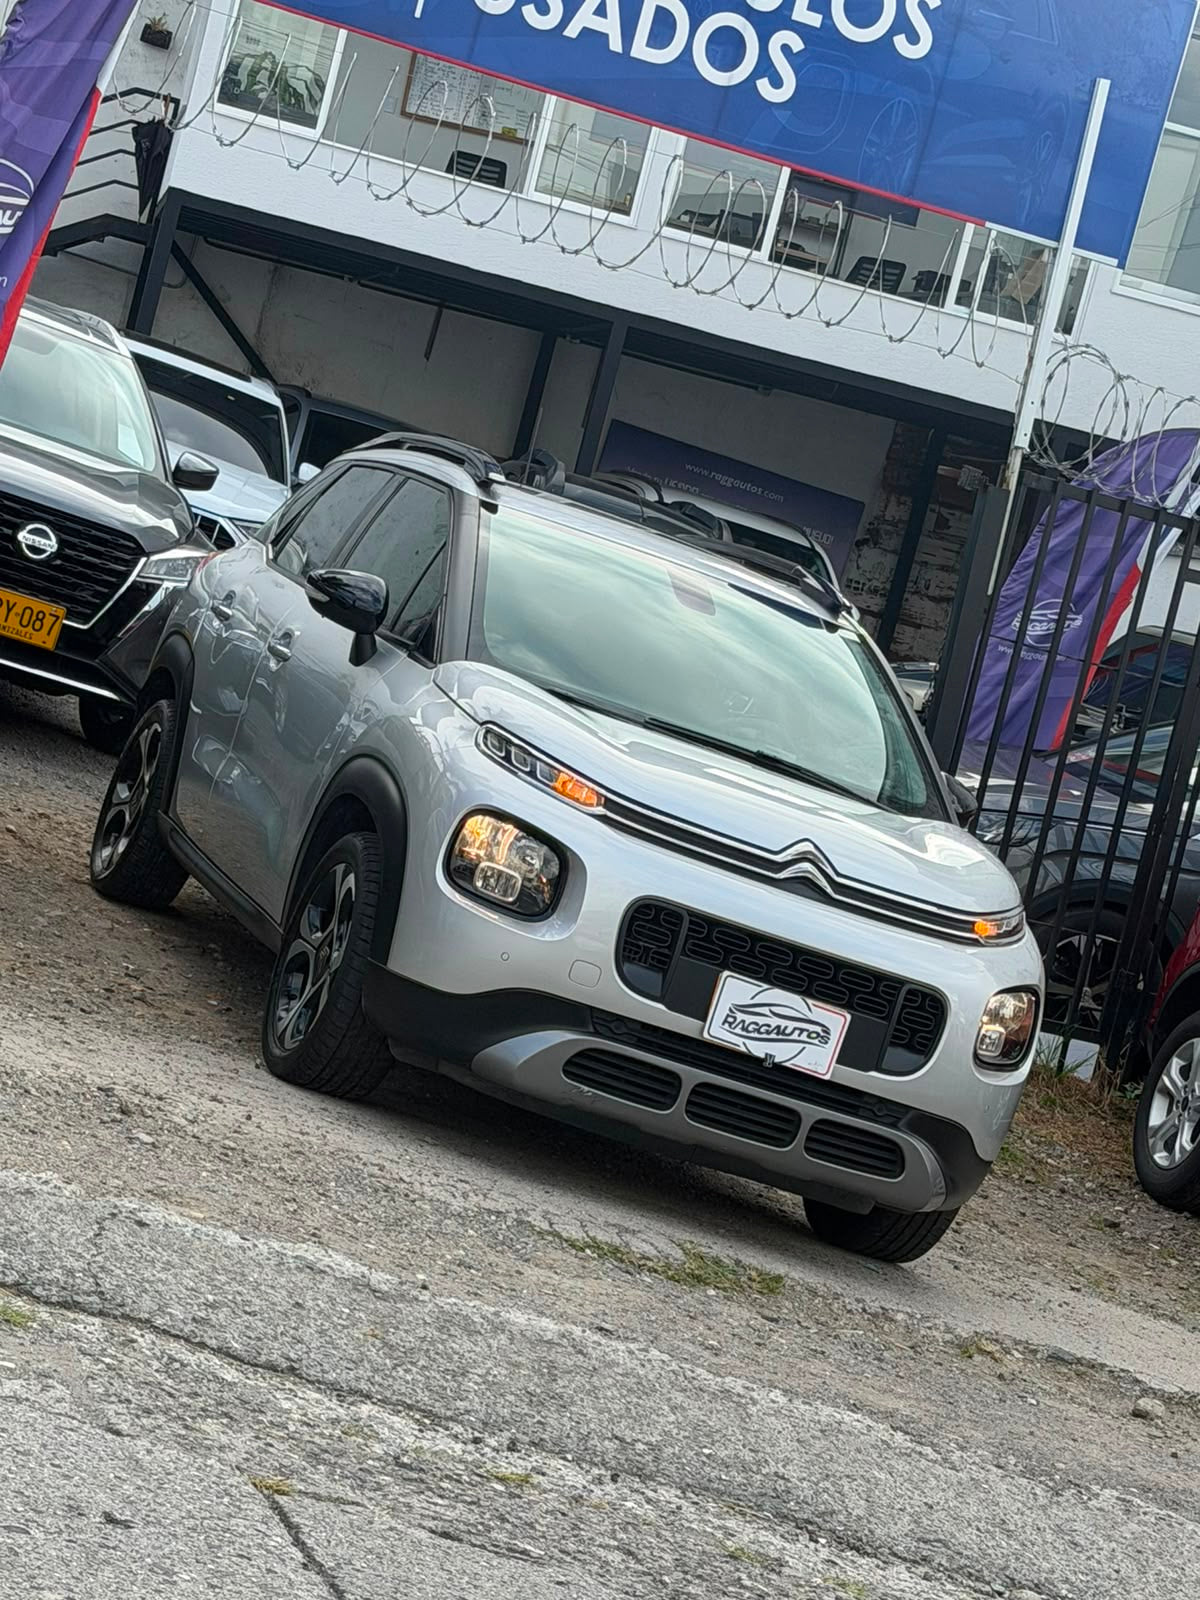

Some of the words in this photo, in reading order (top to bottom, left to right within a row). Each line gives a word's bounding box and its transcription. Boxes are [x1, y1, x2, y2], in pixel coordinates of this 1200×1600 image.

[474, 0, 806, 104] ADOS
[685, 463, 784, 503] www.raggautos.com
[22, 535, 55, 550] NISSAN
[721, 1013, 831, 1045] RAGGAUTOS
